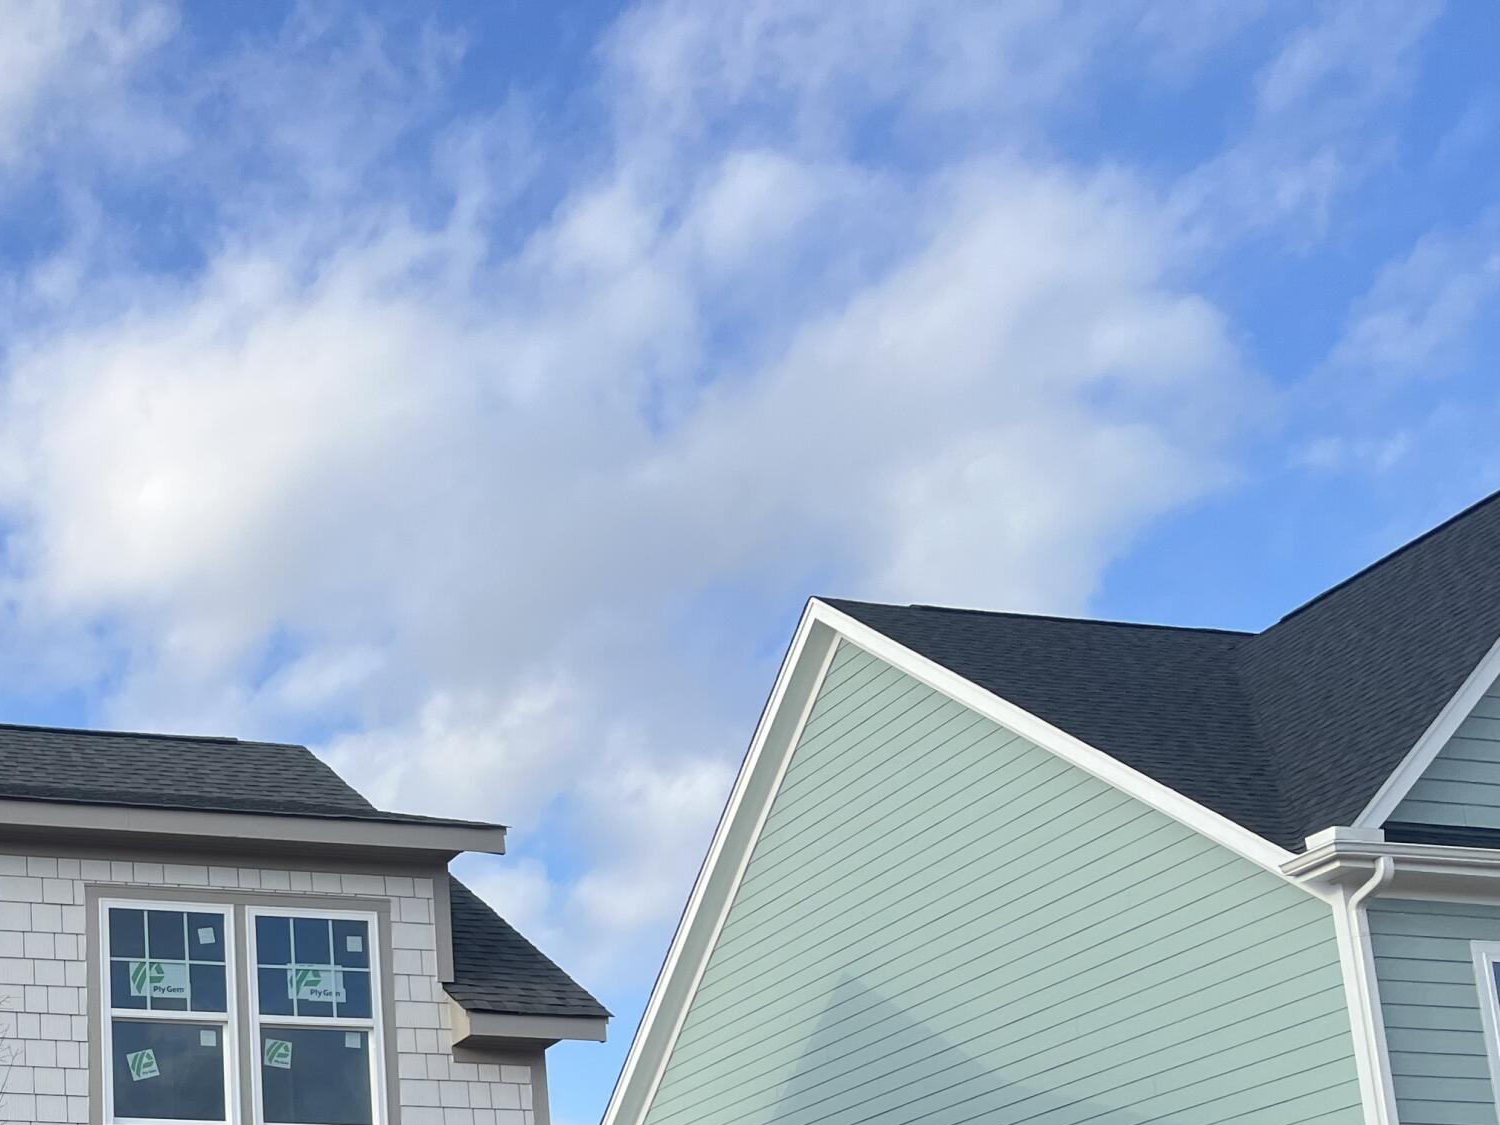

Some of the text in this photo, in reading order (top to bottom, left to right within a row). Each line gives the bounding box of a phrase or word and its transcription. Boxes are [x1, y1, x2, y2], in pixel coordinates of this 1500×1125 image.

[153, 985, 185, 994] Ply Gem
[310, 989, 322, 998] Ply
